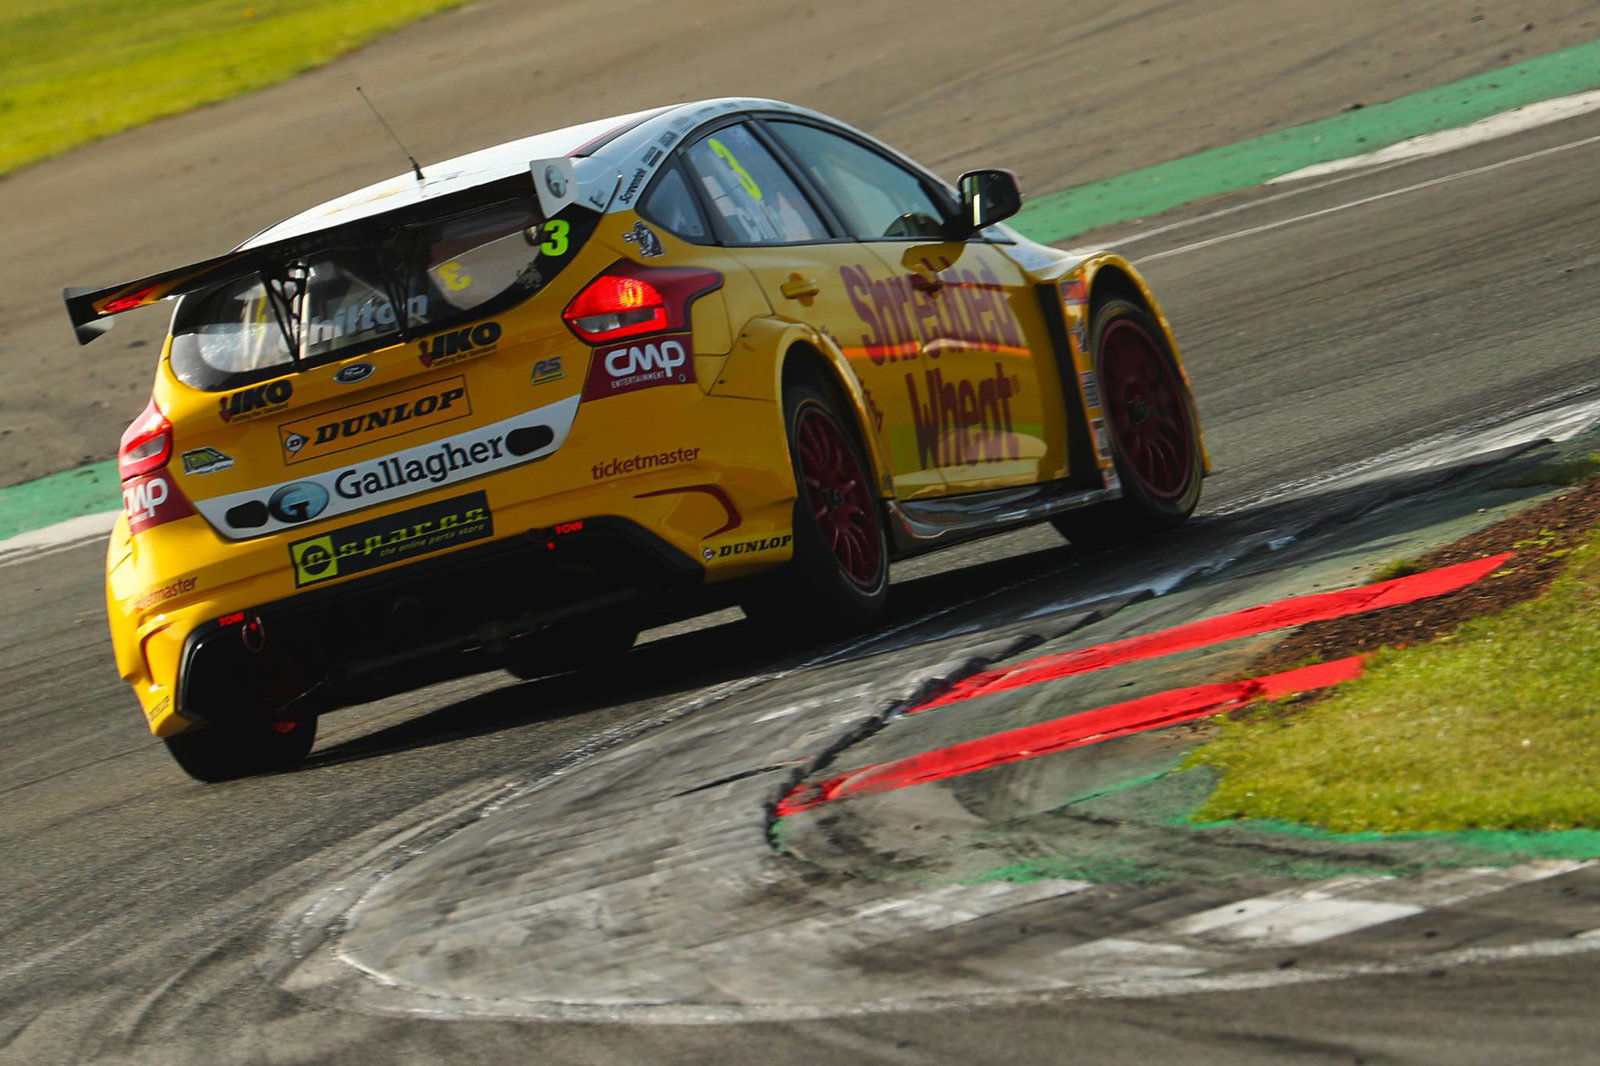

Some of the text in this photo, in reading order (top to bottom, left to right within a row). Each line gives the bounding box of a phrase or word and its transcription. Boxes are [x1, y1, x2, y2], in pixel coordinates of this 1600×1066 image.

[707, 138, 763, 200] 3
[541, 219, 570, 257] 3
[839, 254, 1024, 367] Shredded
[531, 356, 563, 379] RS
[604, 340, 686, 377] CMP
[611, 370, 666, 389] ENTERTAINMENT
[313, 387, 465, 446] DUNLOP
[904, 362, 1021, 470] Wheat
[335, 436, 504, 499] Gallagher
[591, 448, 701, 480] ticketmaster
[555, 520, 584, 535] TOW
[718, 535, 793, 558] DUNLOP
[219, 611, 245, 627] TOW
